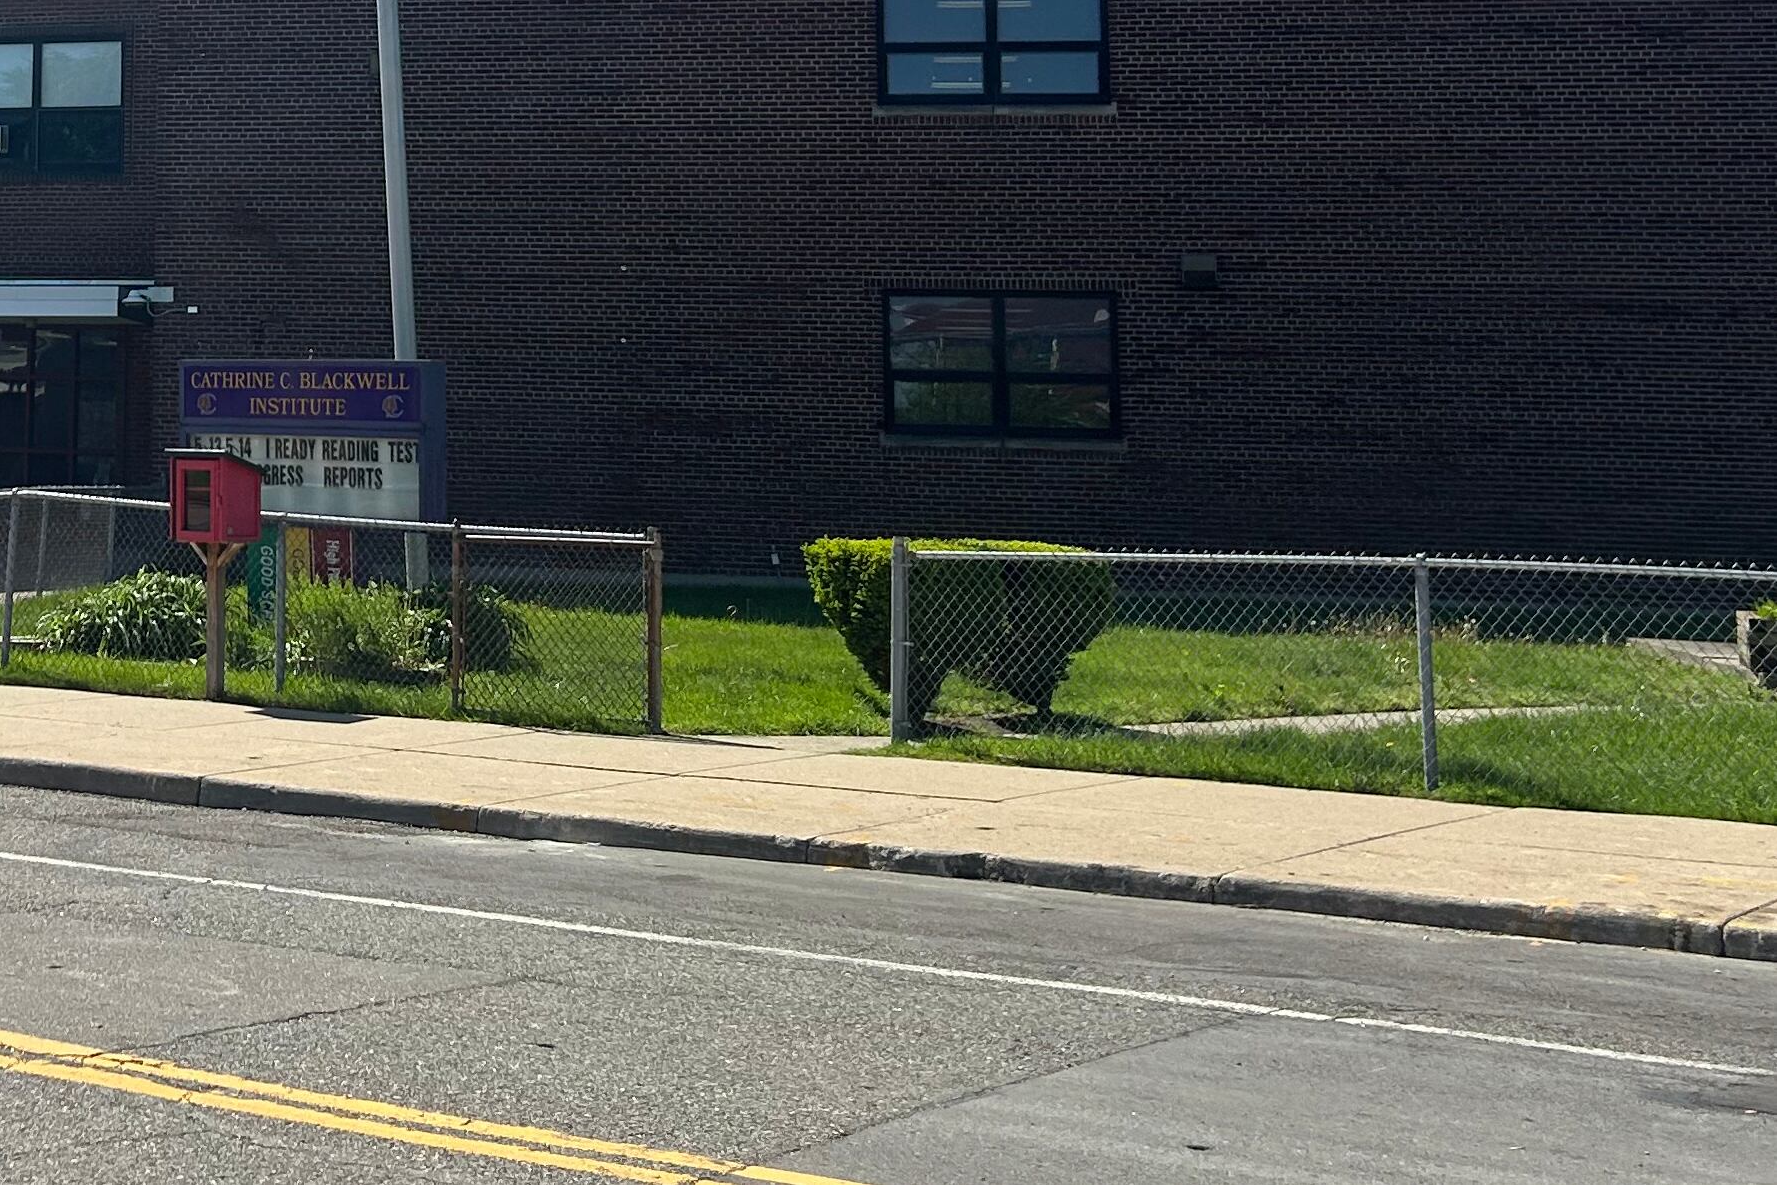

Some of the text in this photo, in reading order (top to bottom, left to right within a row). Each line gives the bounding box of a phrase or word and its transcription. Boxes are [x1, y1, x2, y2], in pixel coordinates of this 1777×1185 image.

[191, 371, 275, 389] CATHRINE
[299, 372, 410, 390] BLACKWELL
[249, 397, 346, 415] INSTITUTE
[266, 438, 270, 459] I
[275, 438, 316, 460] READY
[322, 439, 379, 462] READING
[258, 464, 383, 490] GRESS REPORTS
[261, 545, 274, 586] GOOD
